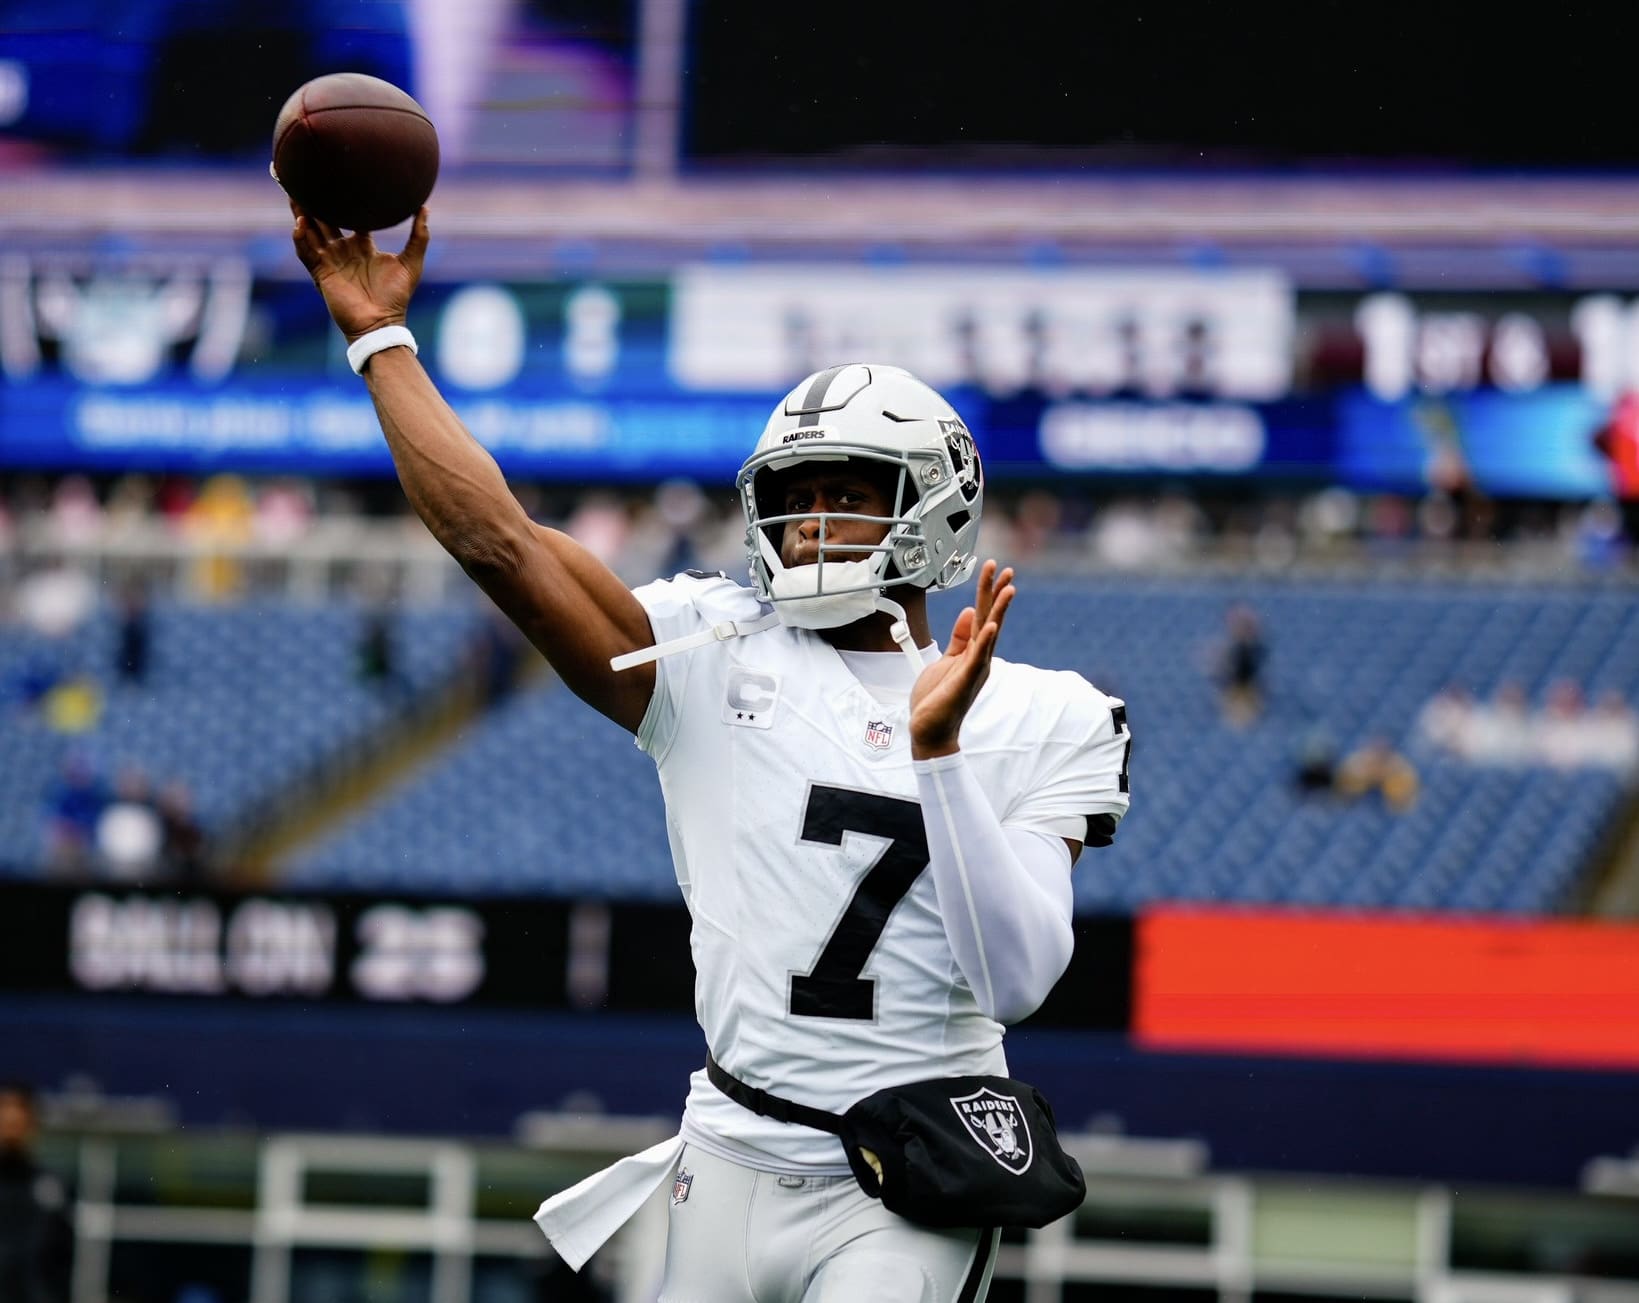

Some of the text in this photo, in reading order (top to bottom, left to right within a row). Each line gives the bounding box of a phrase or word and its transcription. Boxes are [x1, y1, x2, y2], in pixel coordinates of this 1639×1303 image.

[782, 430, 825, 444] RAIDERS
[727, 672, 777, 713] C
[867, 730, 888, 744] NFL
[787, 782, 930, 1022] 7
[961, 1100, 1015, 1113] RAIDERS
